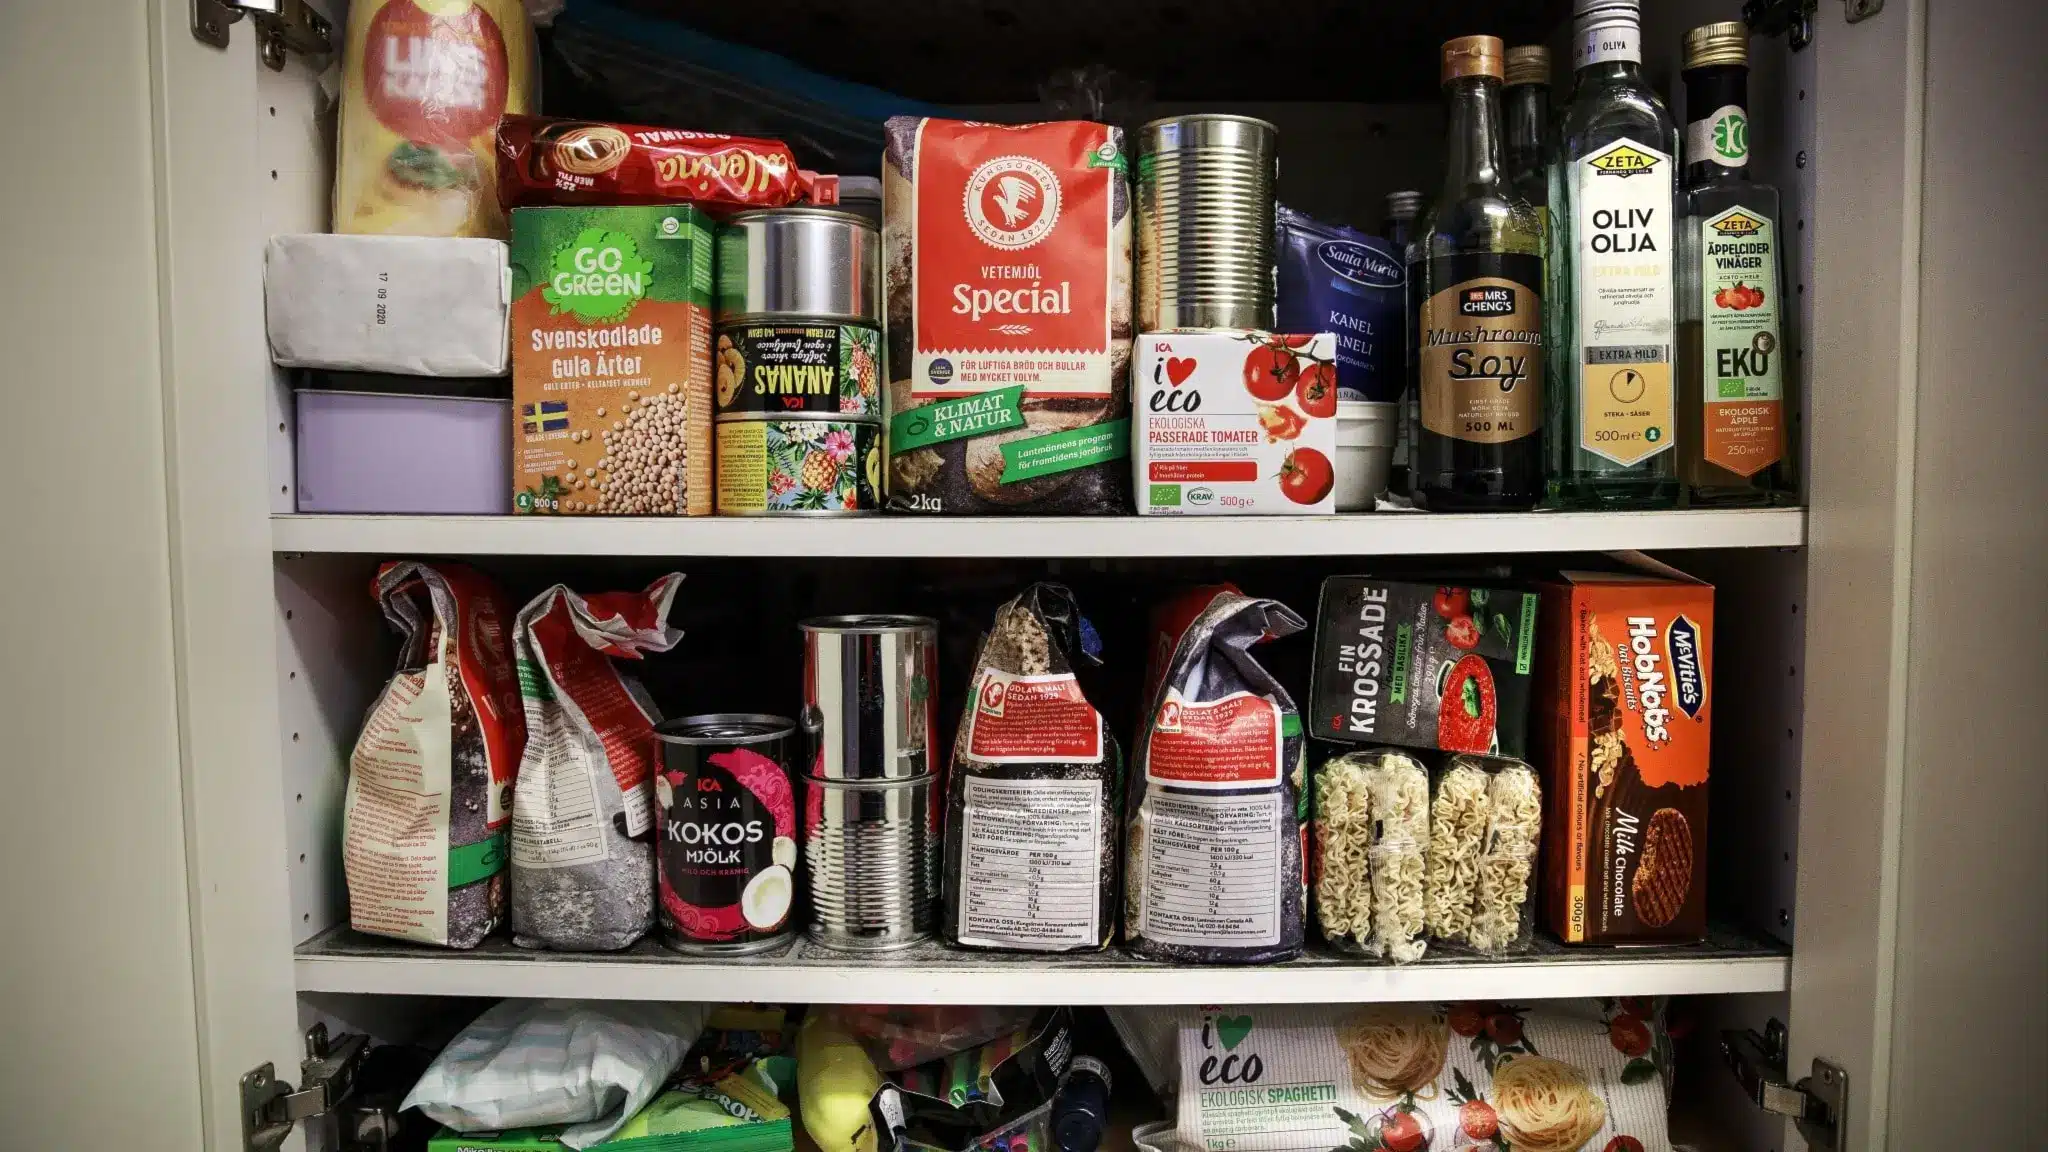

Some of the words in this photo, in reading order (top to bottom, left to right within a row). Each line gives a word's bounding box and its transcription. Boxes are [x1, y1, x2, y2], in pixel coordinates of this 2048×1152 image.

[1602, 41, 1626, 51] OLIVA
[657, 147, 795, 195] allerina
[1604, 155, 1645, 167] ZETA
[555, 178, 576, 192] 25%
[974, 160, 1051, 192] KUNGSÖRNEN
[1592, 208, 1654, 229] OLIV
[1723, 221, 1752, 229] ZETA
[977, 218, 1016, 242] SEDAN
[1591, 233, 1657, 253] OLJA
[1708, 242, 1769, 255] ÄPPELCIDER
[575, 247, 623, 274] GO
[1327, 246, 1361, 267] Santa
[1363, 258, 1399, 279] Maria
[1715, 254, 1762, 269] VINÄGER
[379, 272, 388, 282] 17
[981, 263, 1042, 279] VETEMJÖL
[378, 288, 387, 299] 09
[952, 281, 1071, 321] Special
[1485, 291, 1507, 300] MRS
[377, 304, 386, 325] 2020
[1463, 301, 1512, 312] CHENG'S
[806, 328, 823, 337] GRAM
[1330, 310, 1374, 335] KANEL
[531, 323, 663, 352] Svenskodlade
[1326, 330, 1373, 356] ANELI
[1427, 326, 1542, 346] Mushroom
[1155, 343, 1172, 353] ICA
[1599, 350, 1631, 361] EXTRA
[1635, 349, 1658, 360] MILD
[552, 355, 591, 380] Gula
[596, 350, 642, 378] Ärter
[960, 359, 976, 371] FÖR
[978, 360, 1011, 371] LUFTIGA
[1013, 359, 1035, 371] BRÖD
[1037, 361, 1053, 371] OCH
[1055, 361, 1086, 371] BULLAR
[1448, 349, 1527, 393] Soy
[1717, 348, 1768, 377] EKO
[754, 365, 835, 395] ANANAS
[960, 372, 978, 382] MED
[979, 372, 1011, 382] MYCKET
[1013, 372, 1042, 382] VOLYM.
[781, 397, 804, 408] ICA
[933, 395, 1004, 422] KLIMAT
[1150, 389, 1202, 412] eco
[1719, 408, 1770, 416] EKOLOGISK
[1730, 416, 1758, 425] ÄPPLE
[934, 423, 945, 437] &
[949, 408, 1012, 434] NATUR
[1150, 417, 1206, 429] EKOLOGISKA
[1465, 421, 1491, 432] 500
[1497, 421, 1514, 431] ML
[1018, 440, 1077, 458] Lantmännens
[1078, 432, 1113, 449] program
[1150, 431, 1208, 443] PASSERADE
[1212, 431, 1259, 443] TOMATER
[1018, 458, 1031, 471] för
[1032, 451, 1079, 467] framtidens
[1078, 443, 1113, 459] jordbruk
[1190, 492, 1213, 500] KRAV
[1579, 609, 1588, 634] Baked
[1396, 633, 1408, 672] BASILIKA
[1579, 636, 1587, 652] with
[1618, 643, 1631, 663] Oat
[1338, 645, 1356, 672] FIN
[1349, 587, 1388, 733] KROSSADE
[1579, 668, 1587, 681] and
[1627, 616, 1669, 742] HobNobs
[1394, 676, 1403, 694] MED
[1622, 666, 1637, 711] Biscuits
[1578, 683, 1586, 723] wholemeal
[1331, 713, 1345, 731] ICA
[1577, 760, 1585, 771] No
[698, 779, 722, 792] ICA
[1577, 773, 1585, 802] artificial
[684, 798, 740, 809] ASIA
[1576, 804, 1584, 831] colours
[668, 819, 763, 845] KOKOS
[1576, 832, 1583, 841] or
[1612, 807, 1640, 856] Milk
[686, 848, 741, 863] MJÖLK
[1575, 843, 1584, 871] flavours
[1614, 857, 1627, 917] Chocolate
[1200, 1053, 1263, 1085] eco
[1201, 1089, 1266, 1108] EKOLOGISK
[1267, 1084, 1337, 1104] SPAGHETTI
